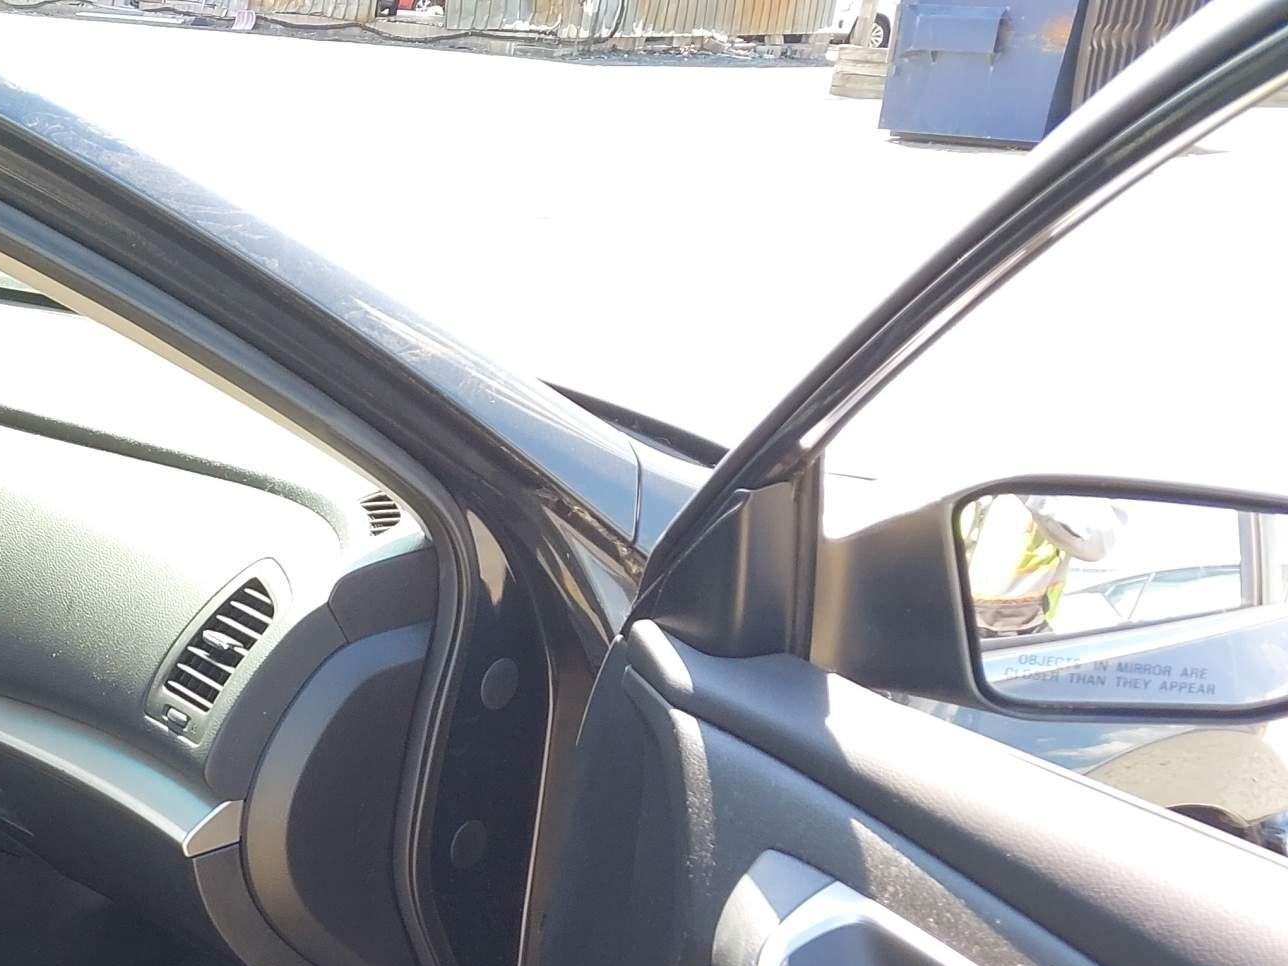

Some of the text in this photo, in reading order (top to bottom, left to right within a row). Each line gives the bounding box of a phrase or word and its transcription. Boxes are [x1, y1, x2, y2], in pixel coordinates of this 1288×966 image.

[1093, 661, 1108, 672] IN
[1116, 661, 1172, 677] MIRROR
[1180, 666, 1209, 680] ARE
[1069, 672, 1107, 687] THAN
[1116, 675, 1153, 690] THEY
[1160, 679, 1216, 695] APPEAR
